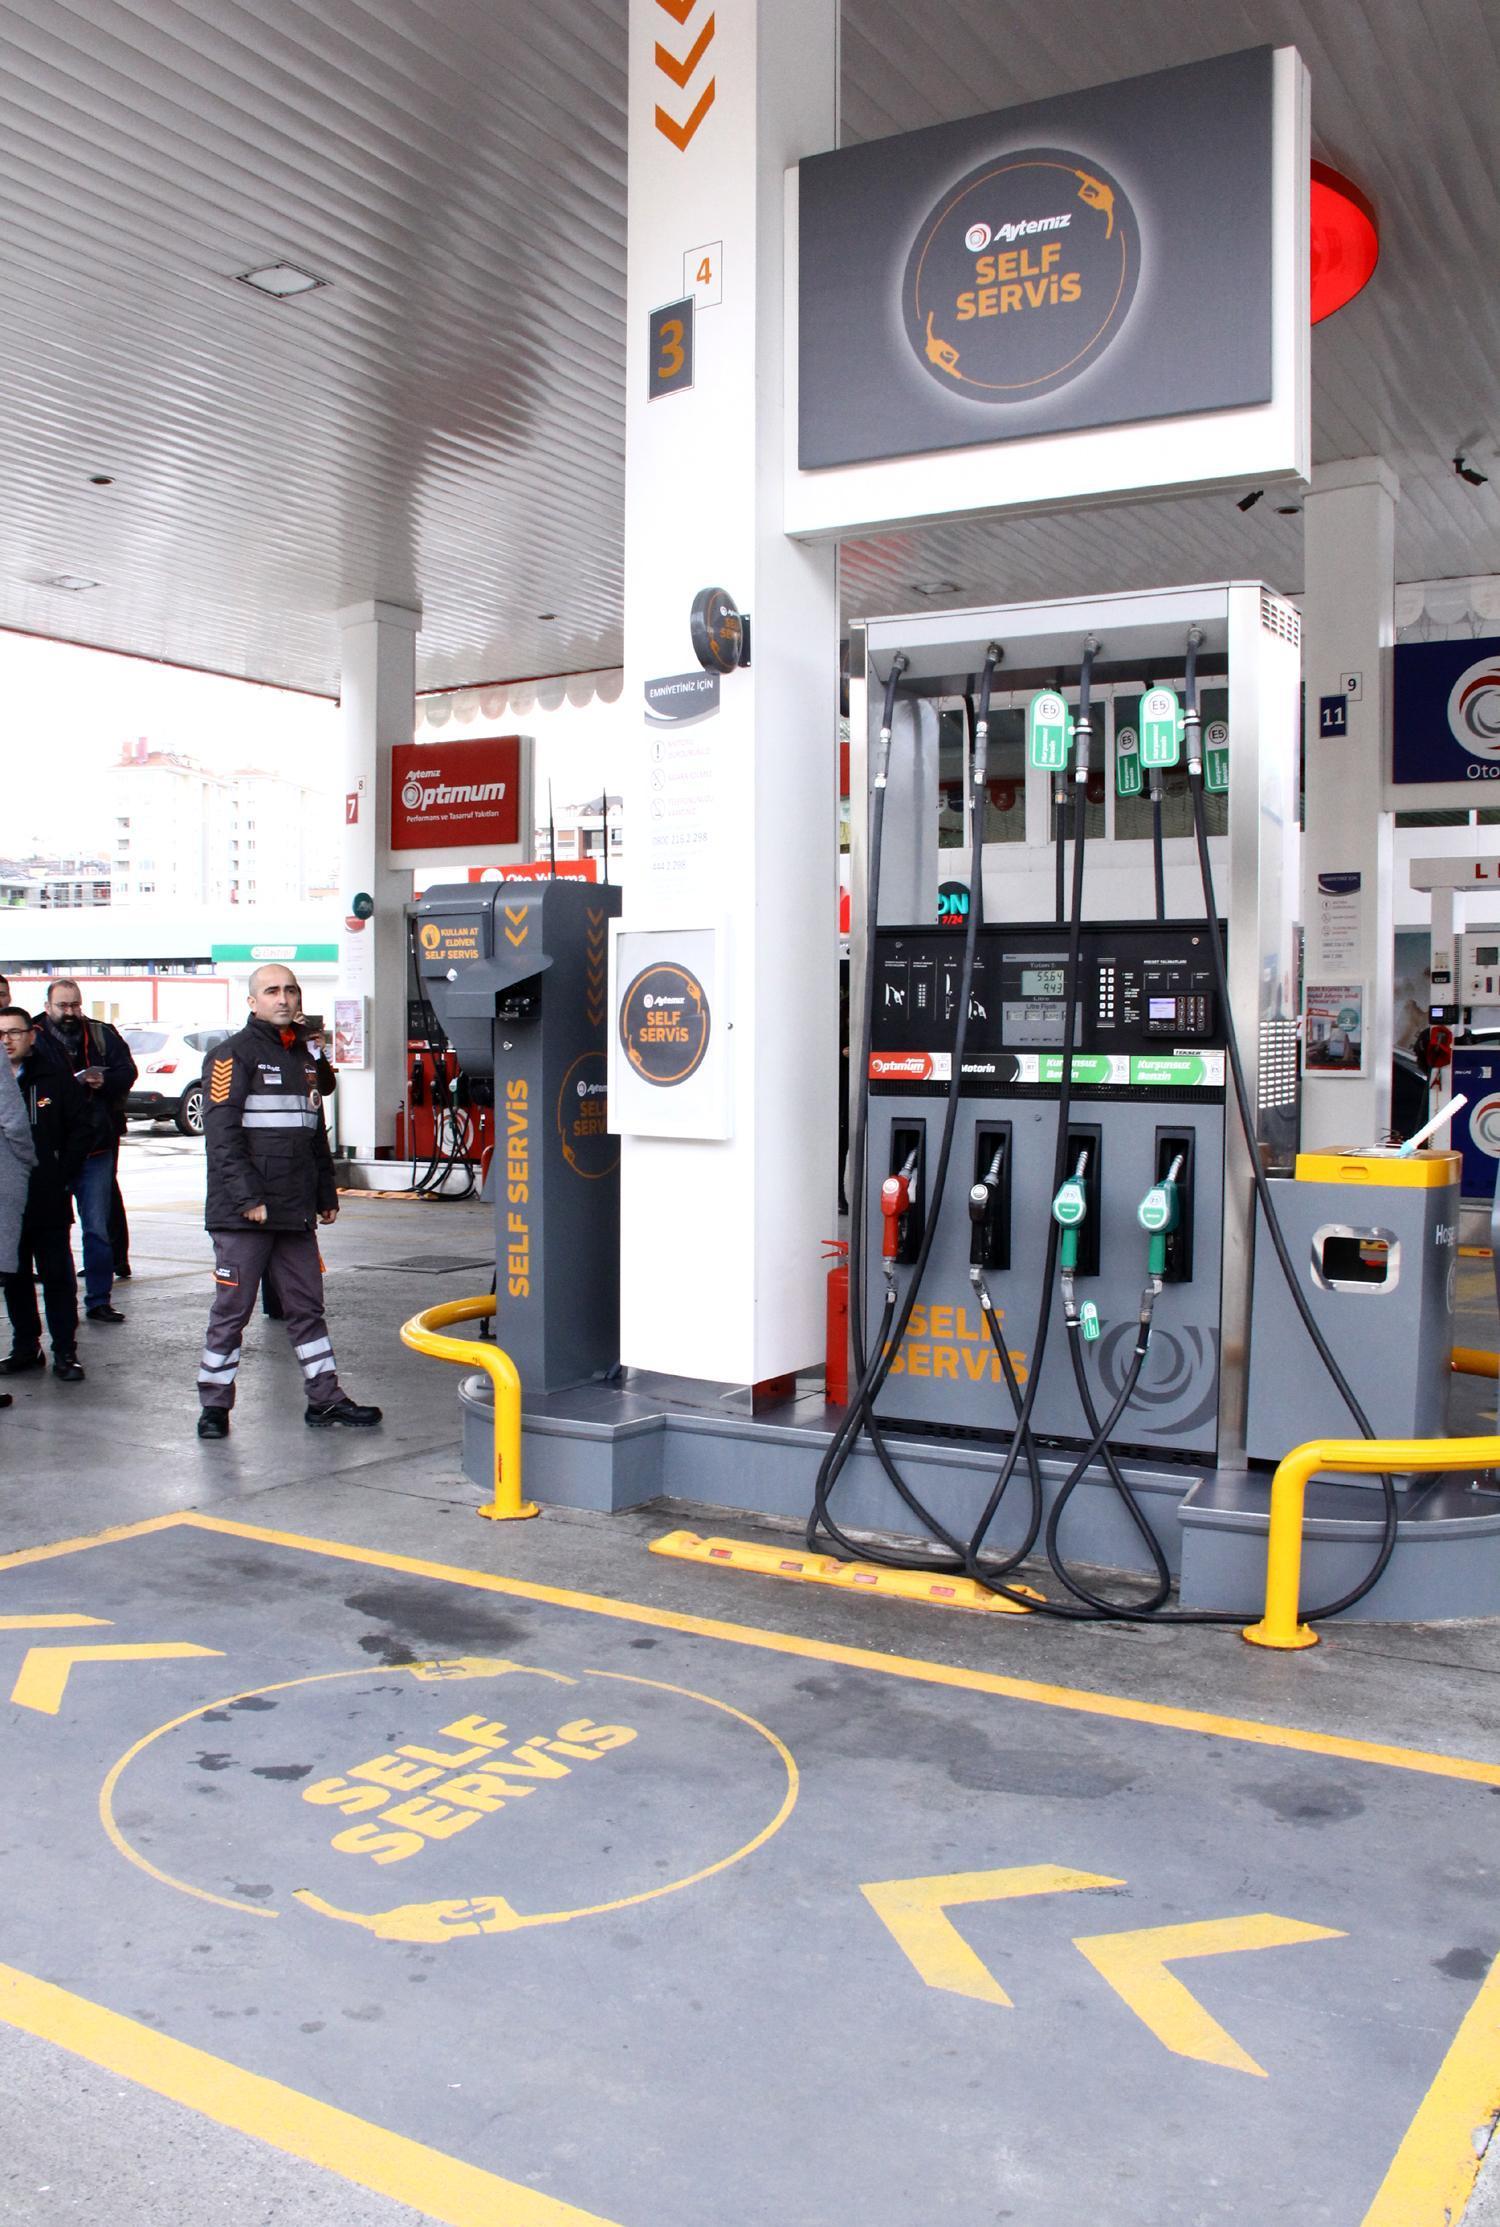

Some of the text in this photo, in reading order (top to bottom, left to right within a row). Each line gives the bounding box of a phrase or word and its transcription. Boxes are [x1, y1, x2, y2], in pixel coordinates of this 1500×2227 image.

[994, 212, 1072, 244] Aytemiz
[695, 256, 712, 285] 4
[975, 243, 1063, 287] SELF
[657, 318, 686, 380] 3
[696, 678, 714, 692] İÇİN
[1348, 677, 1357, 692] 9
[1042, 703, 1057, 715] E5
[1152, 699, 1166, 711] E5
[1322, 706, 1346, 727] 11
[1122, 735, 1132, 745] E5
[1212, 728, 1225, 739] E5
[405, 770, 441, 781] Aytemiz
[1466, 764, 1500, 780] Oto
[359, 780, 364, 790] 8
[347, 798, 356, 819] 7
[406, 814, 440, 823] Performans
[449, 811, 474, 820] Tasarruf
[942, 914, 963, 924] 7/24
[441, 928, 469, 936] KULLAN
[425, 951, 446, 960] SELF
[646, 1011, 681, 1025] SELF
[1137, 1071, 1172, 1081] Benzin
[507, 1212, 530, 1298] SELF
[905, 1304, 1005, 1343] SELF
[302, 1714, 510, 1815] SELF
